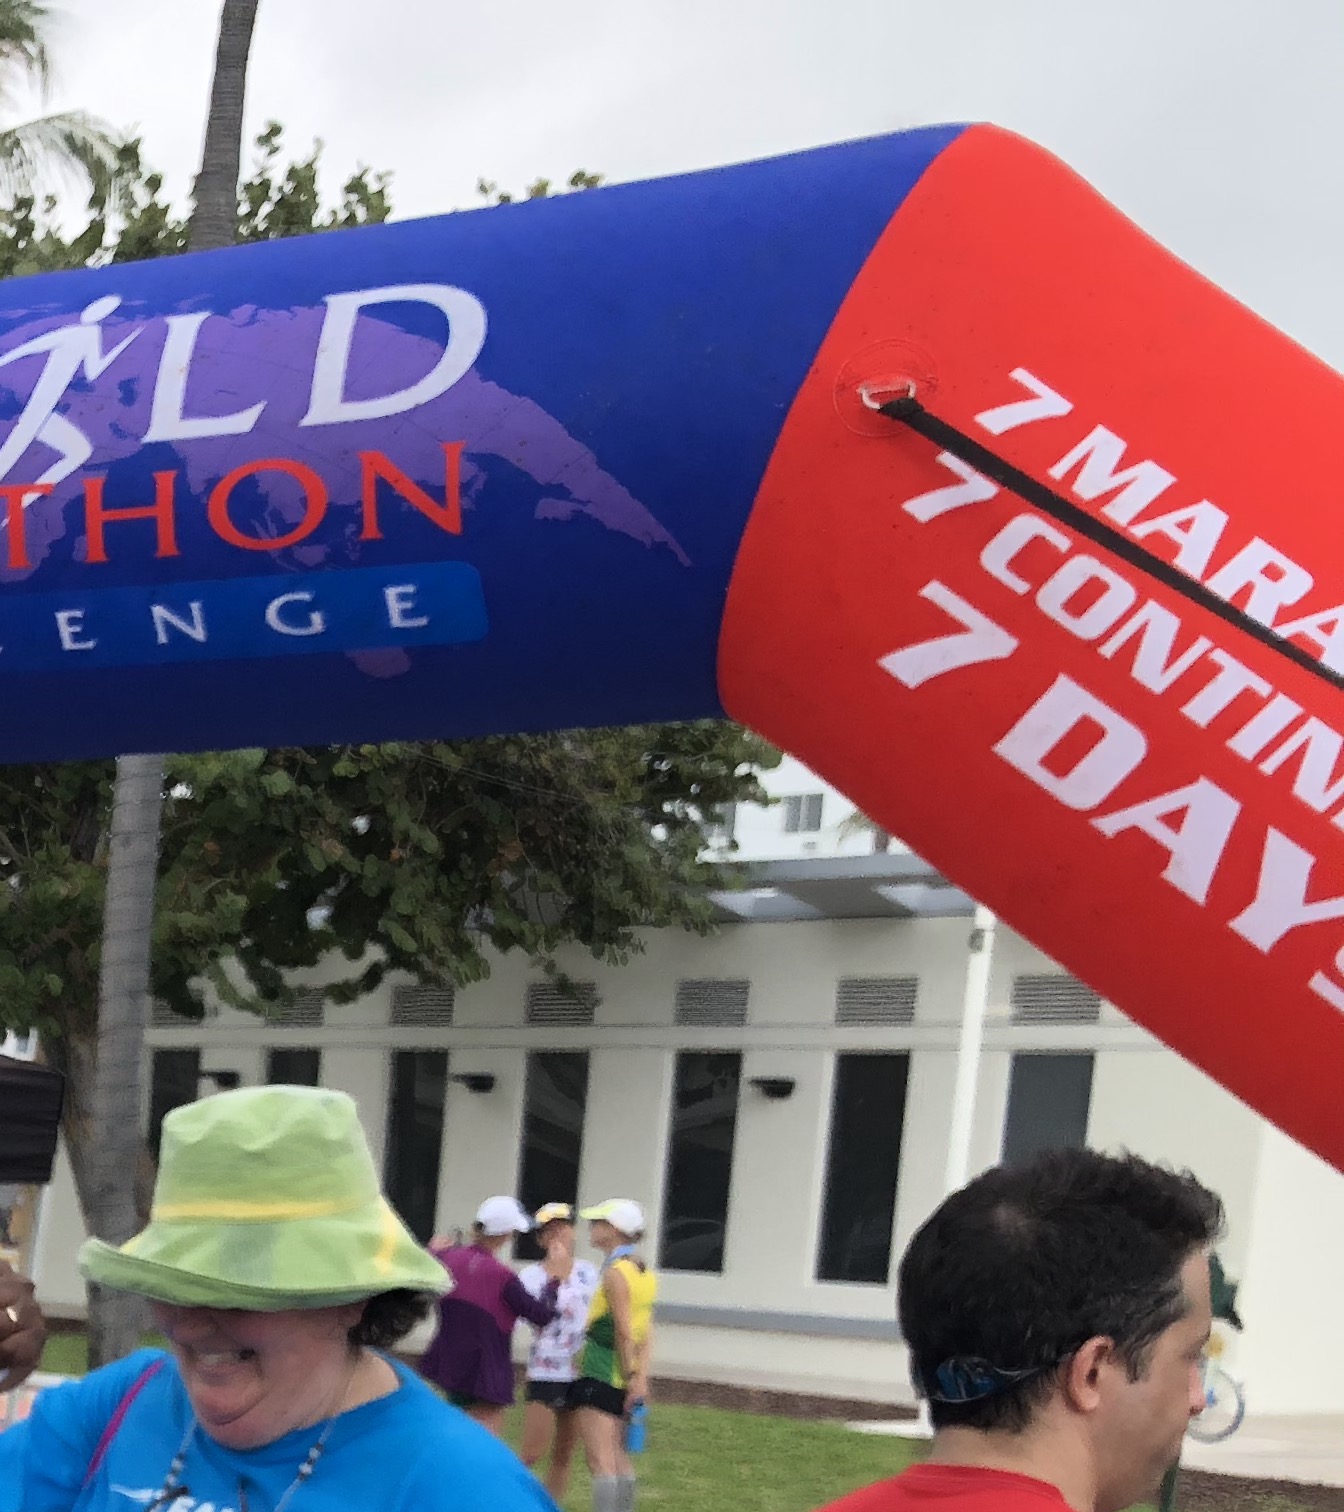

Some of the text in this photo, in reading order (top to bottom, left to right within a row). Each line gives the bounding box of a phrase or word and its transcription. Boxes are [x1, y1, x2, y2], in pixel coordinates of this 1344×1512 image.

[973, 367, 1075, 437] 7
[901, 449, 1001, 525] 7
[877, 579, 1020, 690] 7
